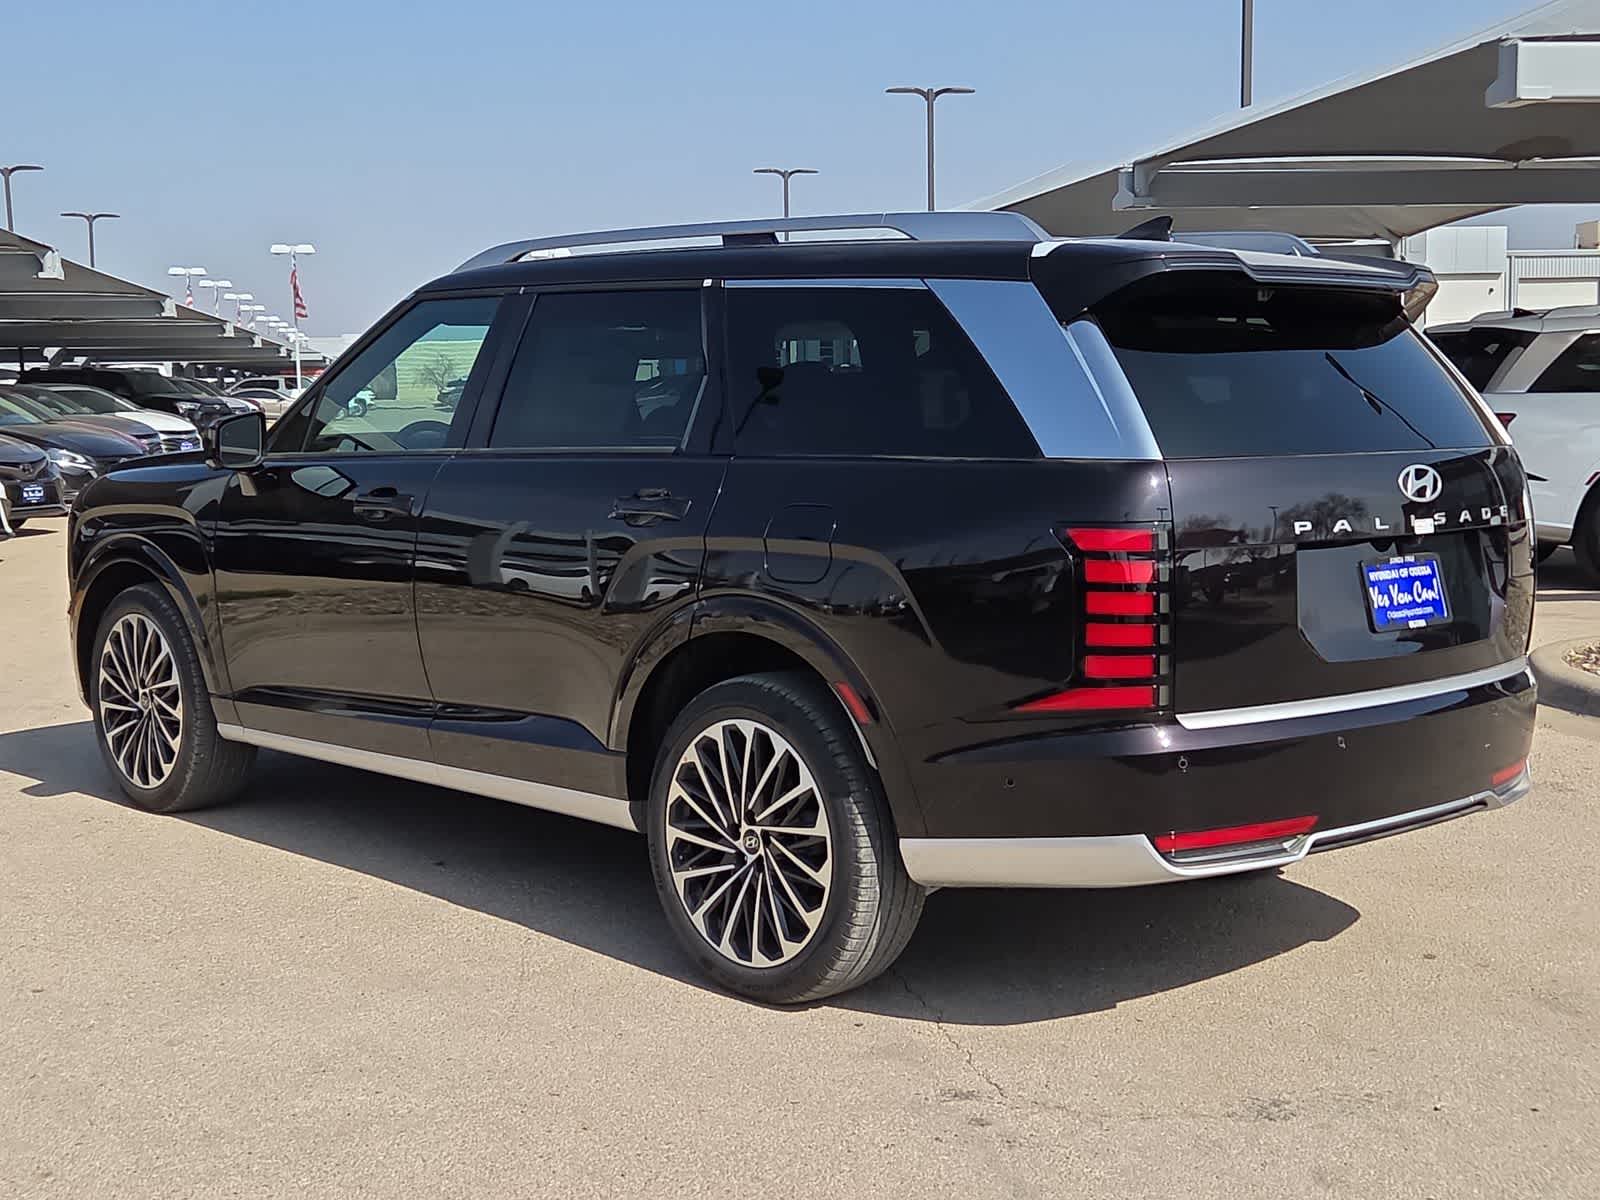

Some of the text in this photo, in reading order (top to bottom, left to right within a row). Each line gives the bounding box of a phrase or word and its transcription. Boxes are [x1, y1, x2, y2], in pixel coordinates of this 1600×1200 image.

[1293, 504, 1509, 535] PALISADE
[1369, 577, 1439, 608] Yes You Can!
